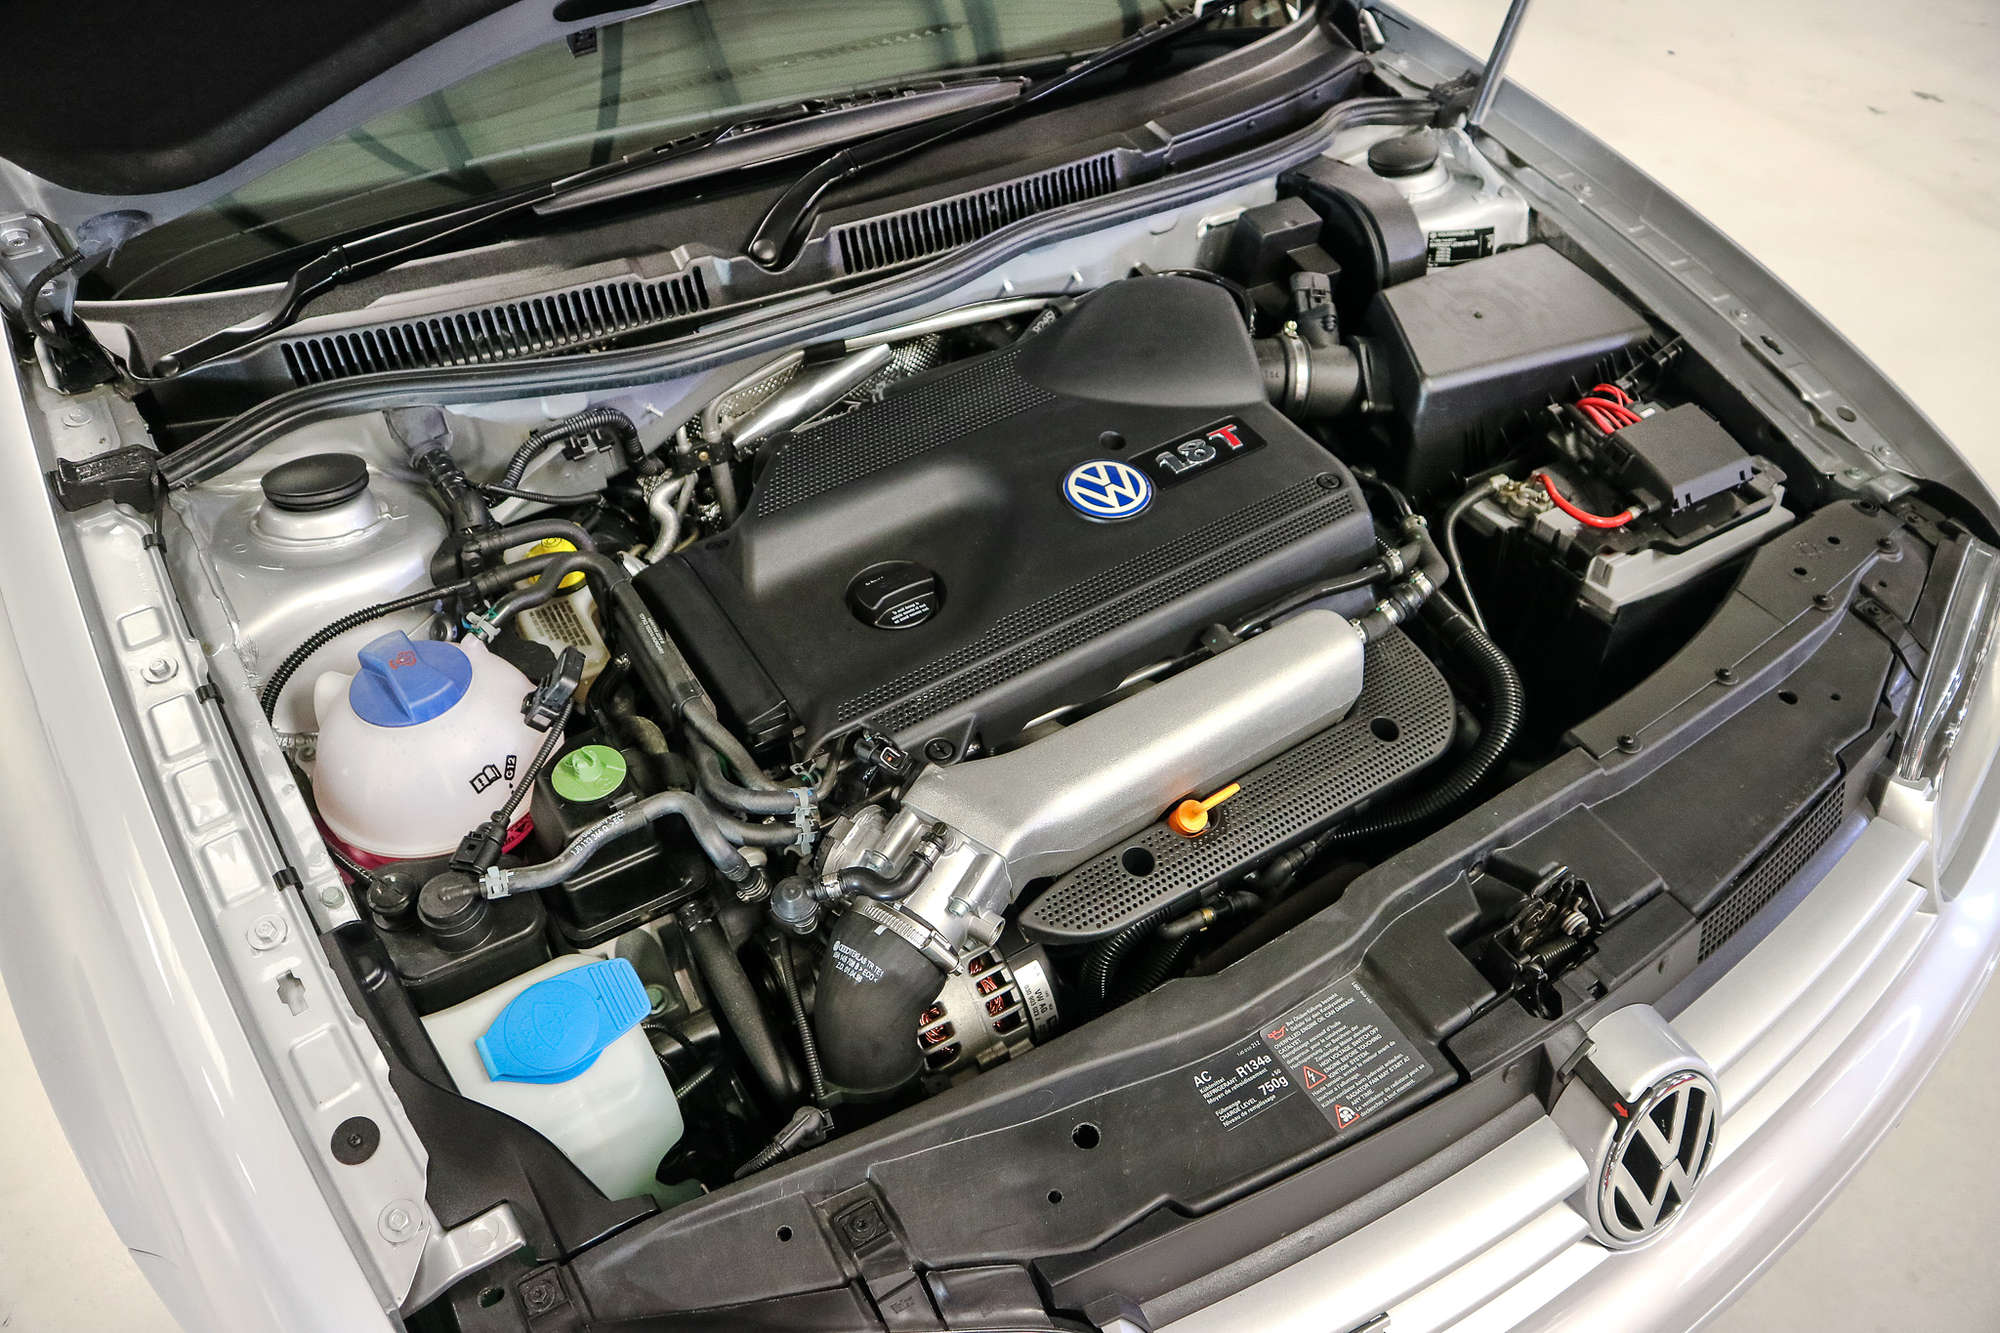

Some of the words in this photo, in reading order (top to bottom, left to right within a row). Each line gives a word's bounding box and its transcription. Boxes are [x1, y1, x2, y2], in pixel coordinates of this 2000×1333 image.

[505, 757, 516, 779] G12
[1034, 988, 1044, 1002] VW
[1274, 1031, 1301, 1049] OVERFILLED
[1300, 1020, 1318, 1033] ENGINE
[1324, 1009, 1336, 1018] CAN
[1334, 997, 1355, 1012] DAMAGE
[1318, 1057, 1332, 1067] HIGH
[1351, 1033, 1370, 1047] SWITCH
[1323, 1060, 1342, 1073] ENGINE
[1340, 1049, 1359, 1062] BEFORE
[1194, 1071, 1212, 1087] AC
[1199, 1077, 1225, 1094] Kühlmittel
[1203, 1077, 1237, 1099] REFRIGERANT
[1236, 1055, 1272, 1078] R134a
[1346, 1083, 1369, 1100] RADIATOR
[1368, 1077, 1379, 1085] FAN
[1378, 1069, 1389, 1079] MAY
[1207, 1093, 1225, 1104] Moyen
[1219, 1106, 1241, 1122] CHARGE
[1240, 1098, 1257, 1109] LEVEL
[1258, 1076, 1288, 1095] 750g
[1222, 1115, 1241, 1127] Niveau
[1248, 1094, 1276, 1113] remplissage
[1351, 1097, 1361, 1106] ANY
